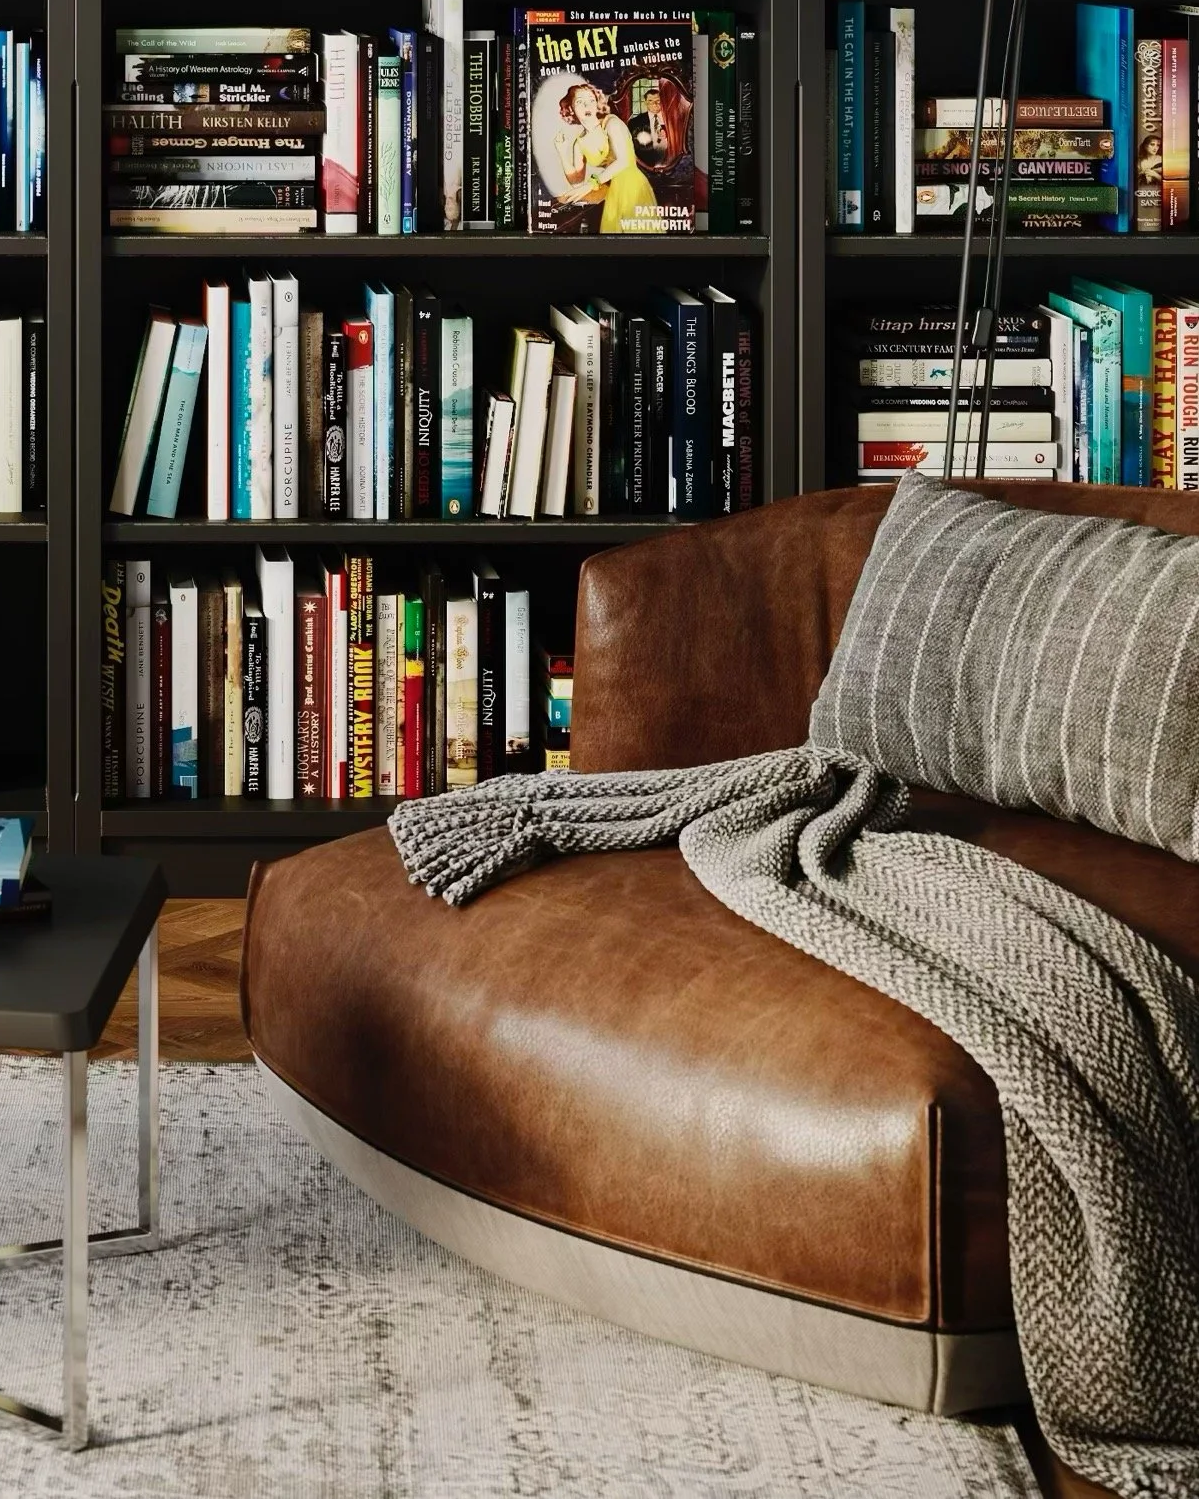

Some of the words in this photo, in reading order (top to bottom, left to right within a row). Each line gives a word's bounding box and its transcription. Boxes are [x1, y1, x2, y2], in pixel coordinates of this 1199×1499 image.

[845, 18, 854, 39] THE
[536, 34, 573, 64] the
[576, 26, 618, 59] KEY
[623, 41, 660, 53] unlocks
[665, 37, 681, 48] the
[845, 42, 854, 63] CAT
[155, 65, 179, 74] History
[180, 65, 189, 73] of
[190, 65, 219, 73] Western
[220, 65, 252, 75] Astrology
[470, 53, 483, 81] THE
[540, 65, 561, 77] door
[566, 64, 576, 74] to
[581, 60, 615, 72] murder
[620, 55, 637, 67] and
[643, 51, 683, 65] violence
[845, 67, 854, 79] IN
[121, 92, 164, 103] Calling
[219, 83, 245, 93] Paul
[250, 83, 266, 93] M.
[219, 94, 270, 102] Strickler
[845, 82, 853, 102] THE
[470, 84, 483, 136] HOBBIT
[716, 100, 724, 127] cover
[844, 106, 853, 128] HAT
[1019, 106, 1098, 117] BEETLEJUICE
[202, 117, 253, 128] KIRSTEN
[257, 117, 291, 128] KELLY
[727, 108, 736, 138] Name
[152, 138, 207, 149] Games
[211, 136, 270, 149] Hunger
[275, 138, 305, 149] The
[504, 135, 512, 160] LADY
[715, 130, 727, 154] your
[712, 156, 724, 166] of
[727, 144, 736, 185] Author
[504, 161, 512, 203] VANISHED
[712, 169, 724, 193] Title
[504, 205, 512, 224] THE
[634, 206, 689, 217] PATRICIA
[538, 222, 557, 230] Mystery
[620, 219, 691, 231] WENTWORTH
[419, 311, 431, 319] #4
[686, 317, 697, 337] THE
[586, 335, 594, 349] THE
[1154, 307, 1177, 384] HARD
[586, 352, 594, 366] BIG
[686, 341, 697, 374] KING'S
[586, 370, 594, 392] SLEEP
[634, 371, 643, 394] THE
[686, 378, 697, 415] BLOOD
[722, 352, 735, 447] MACBETH
[1153, 392, 1176, 420] IT
[586, 402, 594, 445] RAYMOND
[634, 396, 643, 438] PORTER
[174, 428, 182, 443] MAN
[171, 444, 179, 458] AND
[685, 440, 694, 470] SABRINA
[873, 454, 921, 462] HEMINGWAY
[284, 423, 293, 506] PORCUPINE
[586, 447, 594, 490] CHANDLER
[634, 440, 643, 503] PRINCIPLES
[330, 466, 341, 496] HARPER
[330, 497, 341, 512] LEE
[482, 668, 497, 726] INIQUITY
[136, 703, 145, 786] PORCUPINE
[298, 711, 309, 780] HOGWARTS
[311, 711, 319, 764] HISTORY
[249, 747, 259, 776] HARPER
[354, 710, 373, 798] MYSTERY
[249, 778, 259, 792] LEE
[311, 770, 319, 778] A
